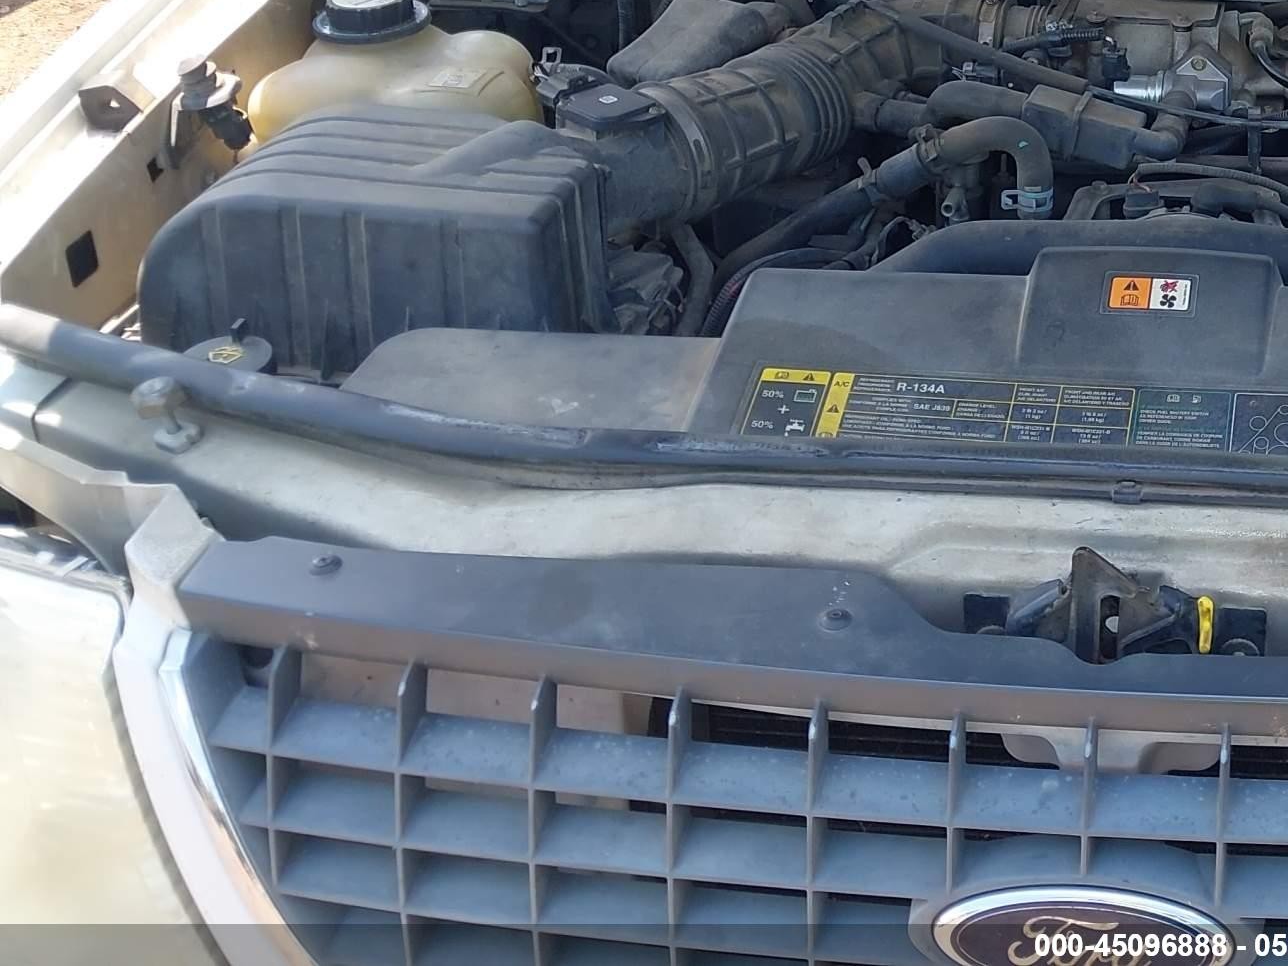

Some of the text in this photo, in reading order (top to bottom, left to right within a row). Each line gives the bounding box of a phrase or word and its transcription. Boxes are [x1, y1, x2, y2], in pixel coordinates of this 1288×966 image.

[896, 382, 945, 394] R-134A
[761, 389, 784, 399] 50%
[913, 403, 930, 411] SAE
[751, 420, 774, 430] 50%
